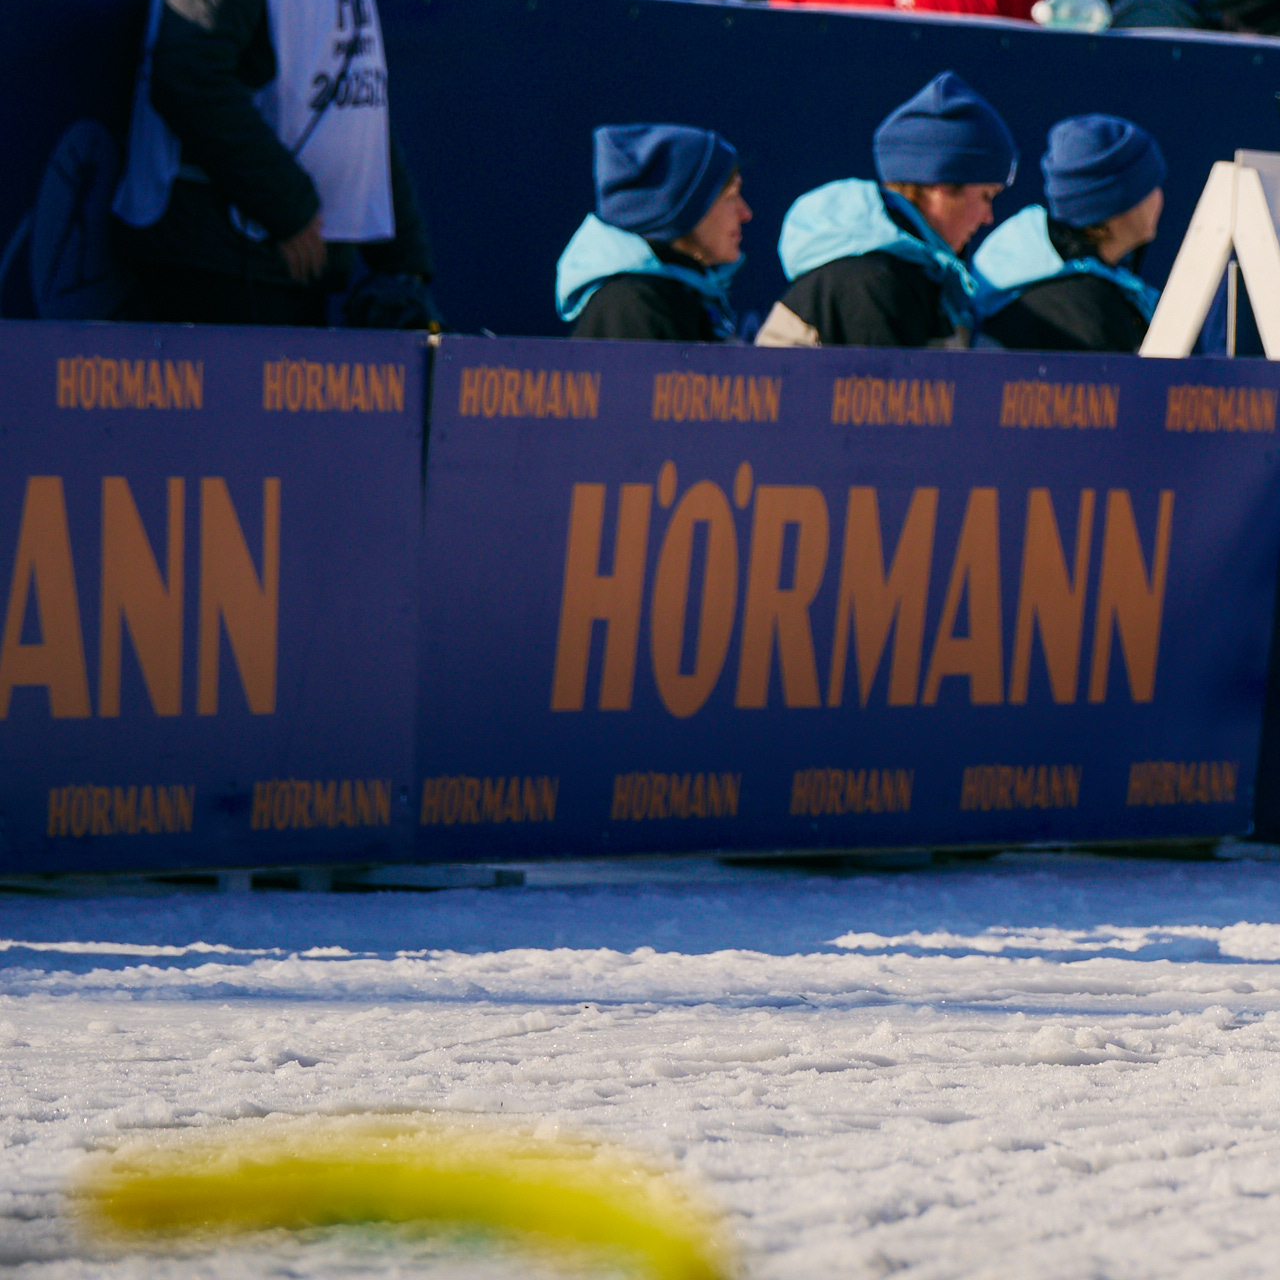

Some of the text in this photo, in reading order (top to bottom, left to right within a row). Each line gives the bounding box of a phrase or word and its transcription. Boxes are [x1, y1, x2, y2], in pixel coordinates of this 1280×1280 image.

[57, 356, 405, 412] HÖRMANN HÖRMANN
[459, 365, 1278, 433] HÖRMANN HÖRMANN HÖRMANN HÖRMANN HÖRMANN
[0, 476, 281, 719] ANN
[550, 460, 1175, 718] HÖRMANN
[47, 778, 392, 837] HÖRMANN HÖRMANN
[419, 775, 559, 825] HÖRMANN
[610, 771, 741, 820] HÖRMANN
[790, 768, 914, 816] HÖRMANN
[960, 765, 1082, 813] HÖRMANN
